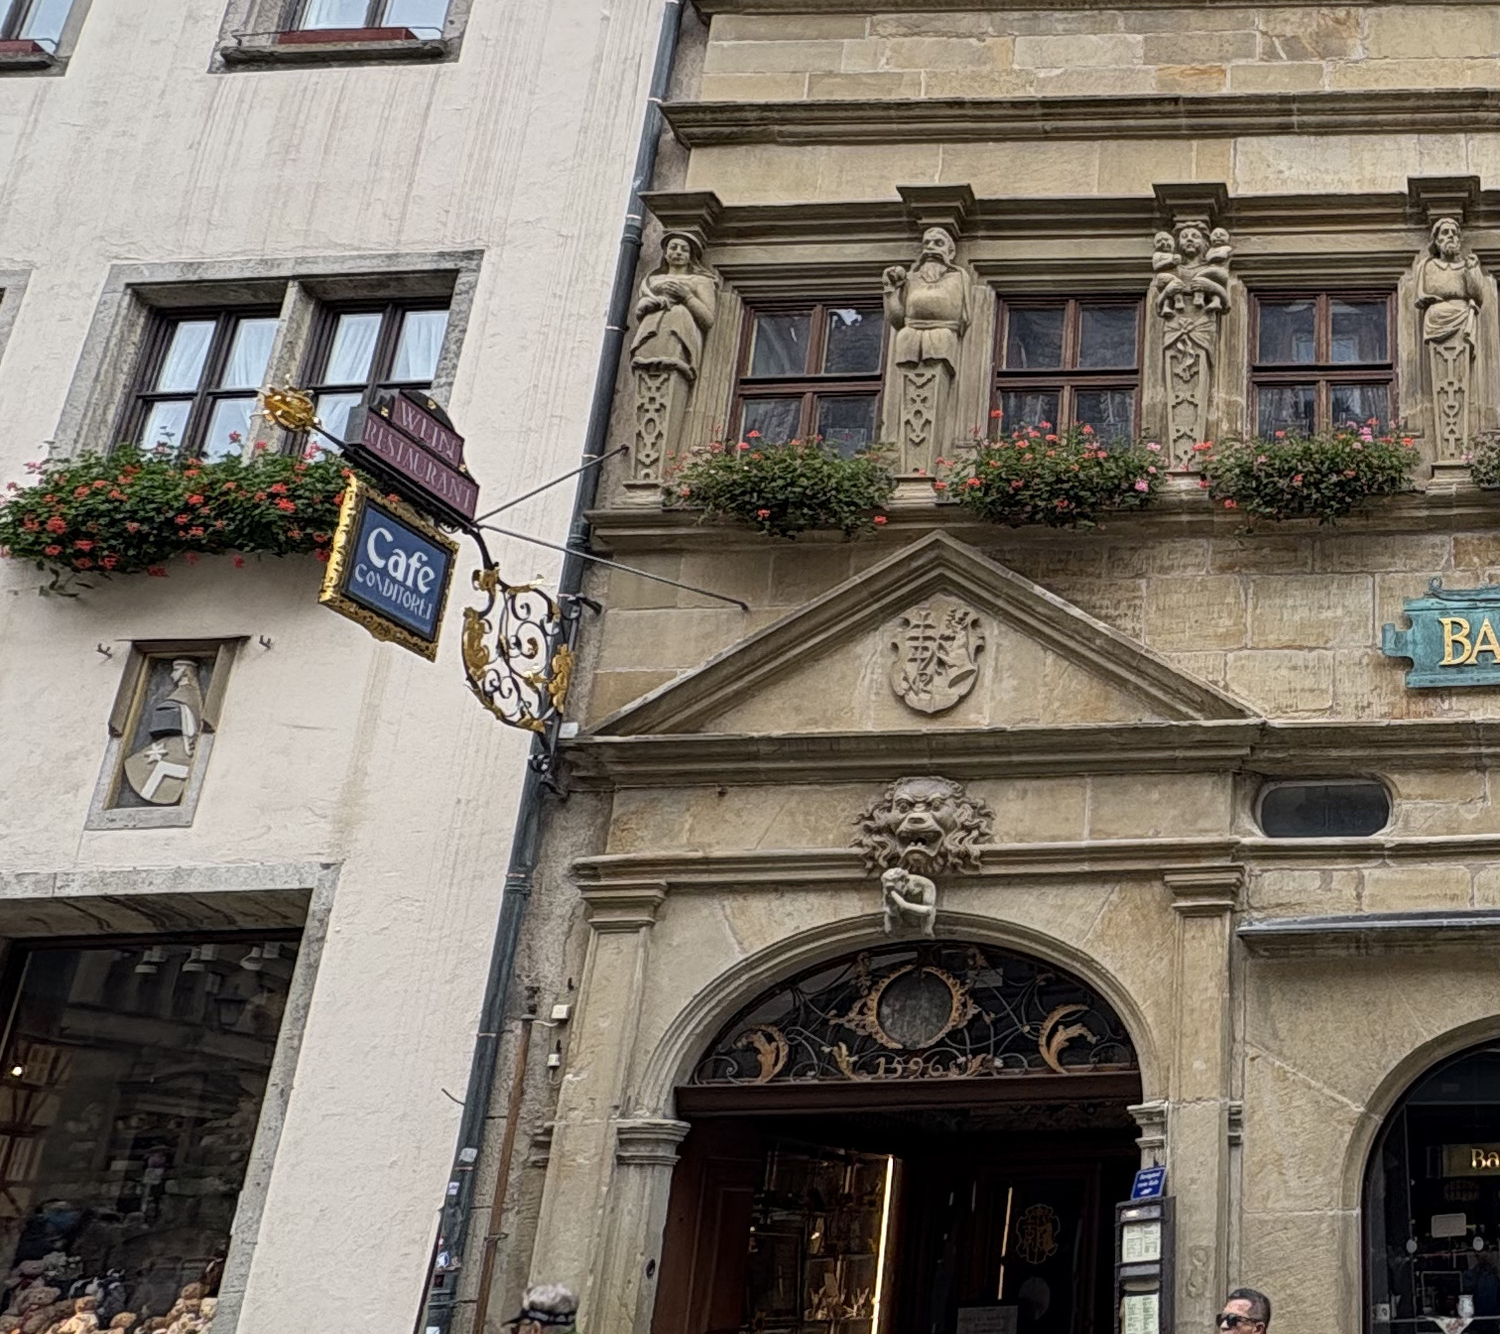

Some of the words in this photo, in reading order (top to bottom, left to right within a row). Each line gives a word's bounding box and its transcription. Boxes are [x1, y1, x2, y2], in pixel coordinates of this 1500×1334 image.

[365, 419, 475, 509] RESTAURANT
[367, 528, 436, 593] Cafe
[354, 563, 433, 621] CONDITOREI
[874, 1055, 944, 1080] 1596
